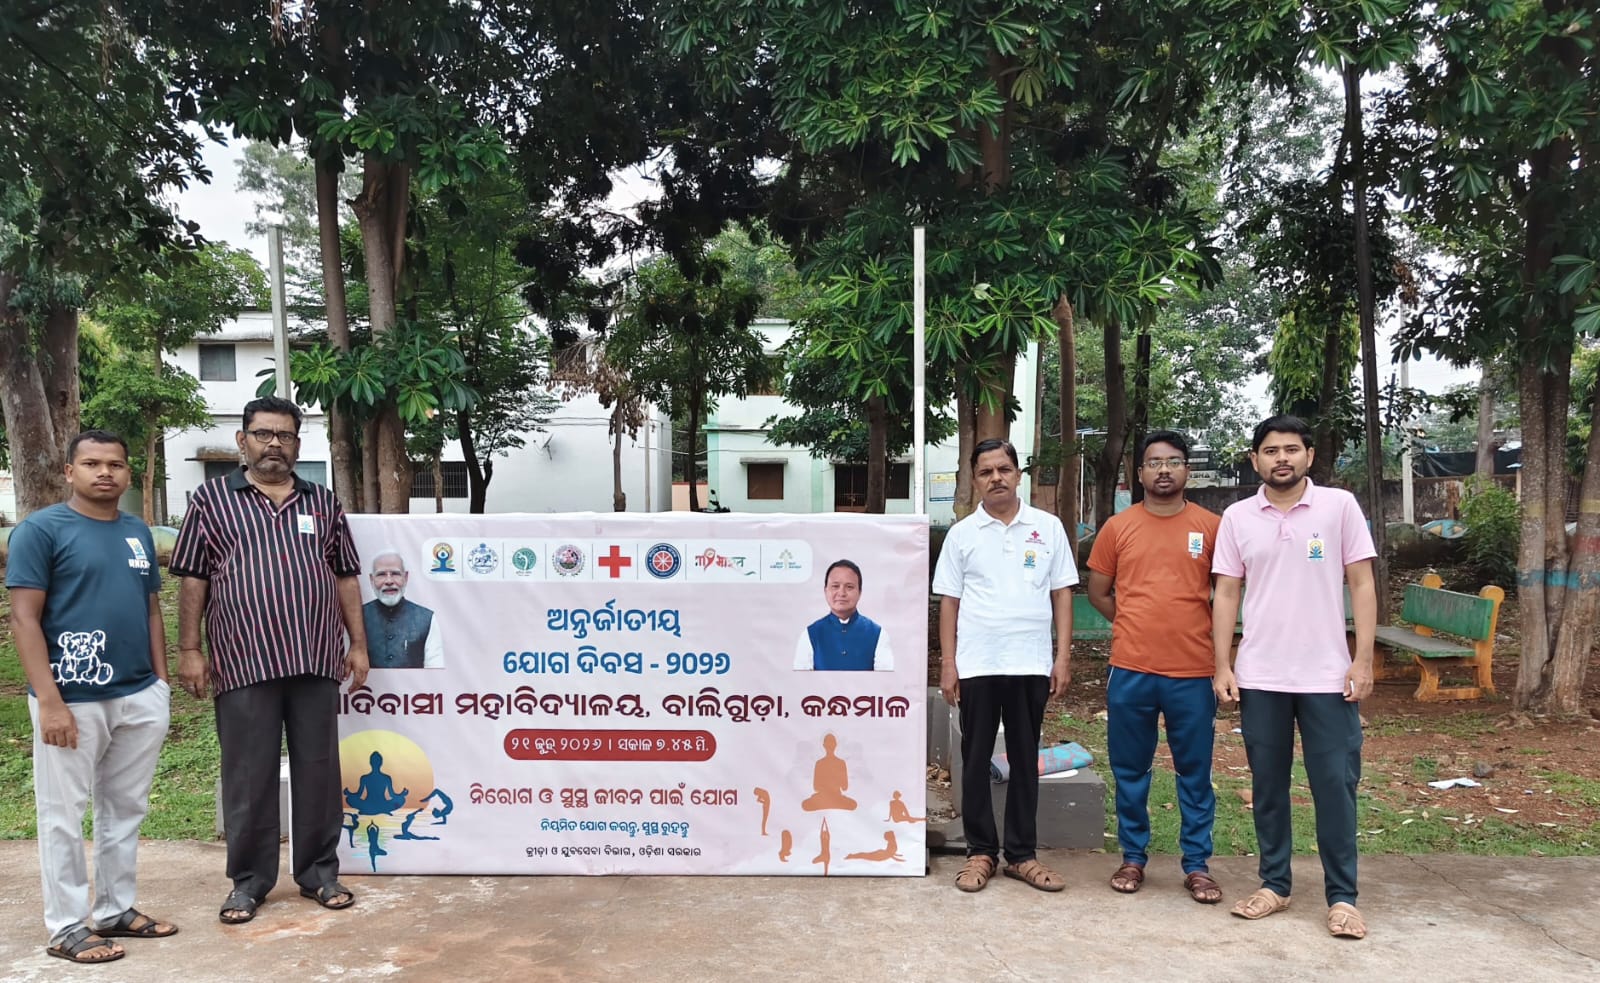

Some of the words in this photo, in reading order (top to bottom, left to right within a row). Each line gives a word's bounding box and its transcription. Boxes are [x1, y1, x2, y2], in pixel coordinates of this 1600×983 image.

[546, 598, 681, 639] ଅନ୍ତର୍ଜାତୀୟ
[503, 651, 569, 674] ଯୋଗ
[577, 645, 643, 675] ଦିବସ
[666, 652, 731, 675] ୨୦୨୬
[455, 686, 651, 721] ମହାବିଦ୍ୟାଳୟ,
[662, 687, 790, 722] ବାଲିଗୁଡ଼ା,
[801, 694, 910, 718] କନ୍ଧମାଳ
[617, 738, 653, 751] ସକାଳ
[470, 782, 533, 805] ନିରୋଗ
[538, 787, 554, 804] ଓ
[560, 787, 589, 808] ସୁସ୍ଥ
[594, 788, 644, 806] ଜୀବନ
[649, 782, 687, 806] ପାଇଁ
[690, 789, 738, 806] ଯୋଗ
[540, 818, 577, 833] ନିୟମିତ
[579, 821, 607, 832] ଯୋଗ
[641, 822, 659, 836] ସୁସ୍ଥ
[661, 822, 690, 838] ରୁହନ୍ତୁ
[551, 846, 558, 856] ଓ
[561, 847, 601, 858] ଯୁବସେବା
[638, 845, 664, 859] ଓଡ଼ିଶା
[667, 847, 702, 857] ସରକାର
